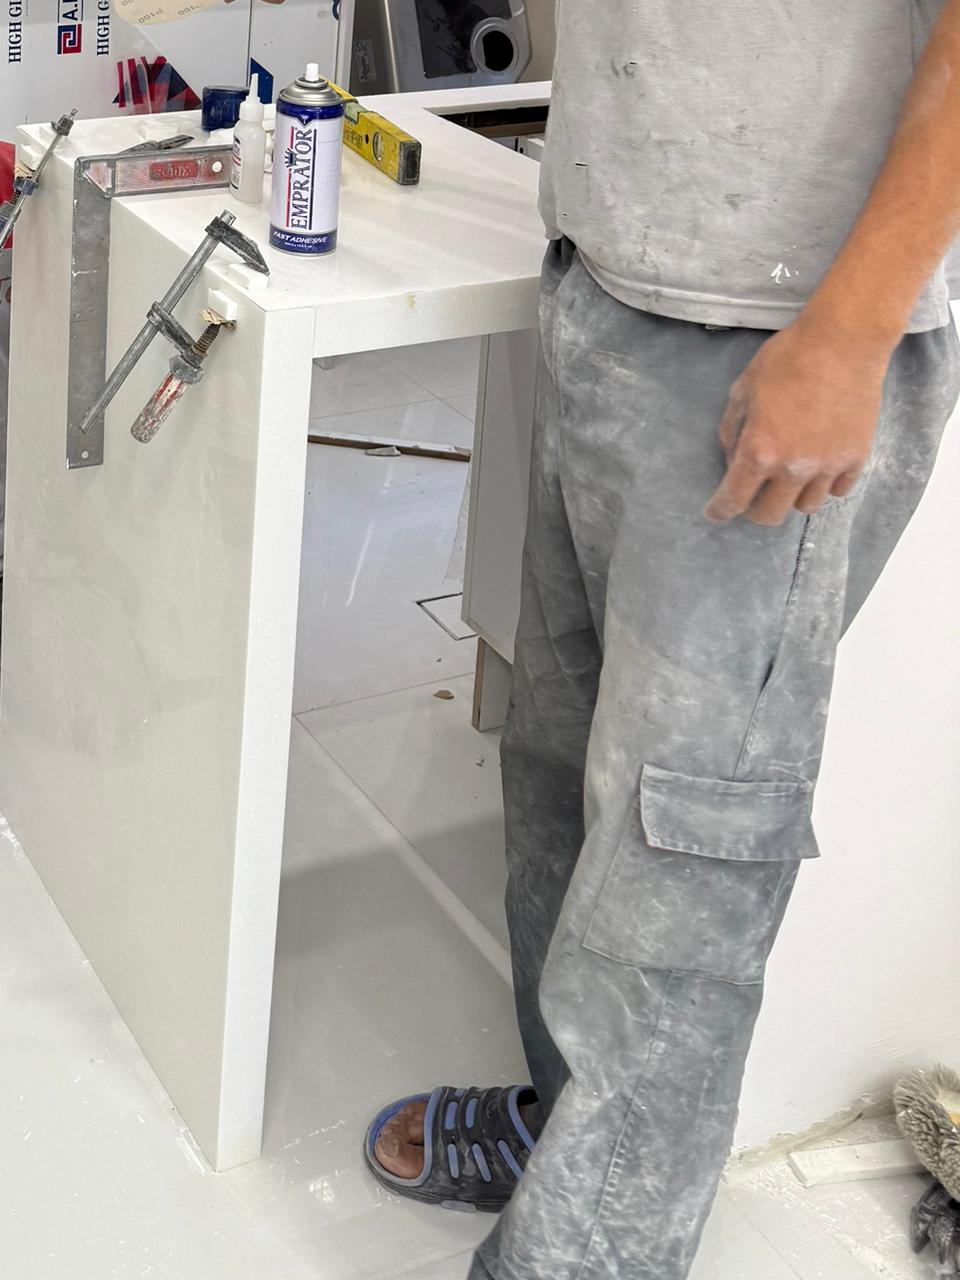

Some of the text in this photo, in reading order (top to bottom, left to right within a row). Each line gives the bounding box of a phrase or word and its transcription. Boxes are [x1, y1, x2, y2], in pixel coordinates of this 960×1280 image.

[8, 21, 22, 64] HIGH
[97, 14, 110, 56] HIGH
[291, 128, 313, 230] EMPRATOR
[273, 231, 291, 241] FAST
[290, 236, 328, 245] ADHESIVE
